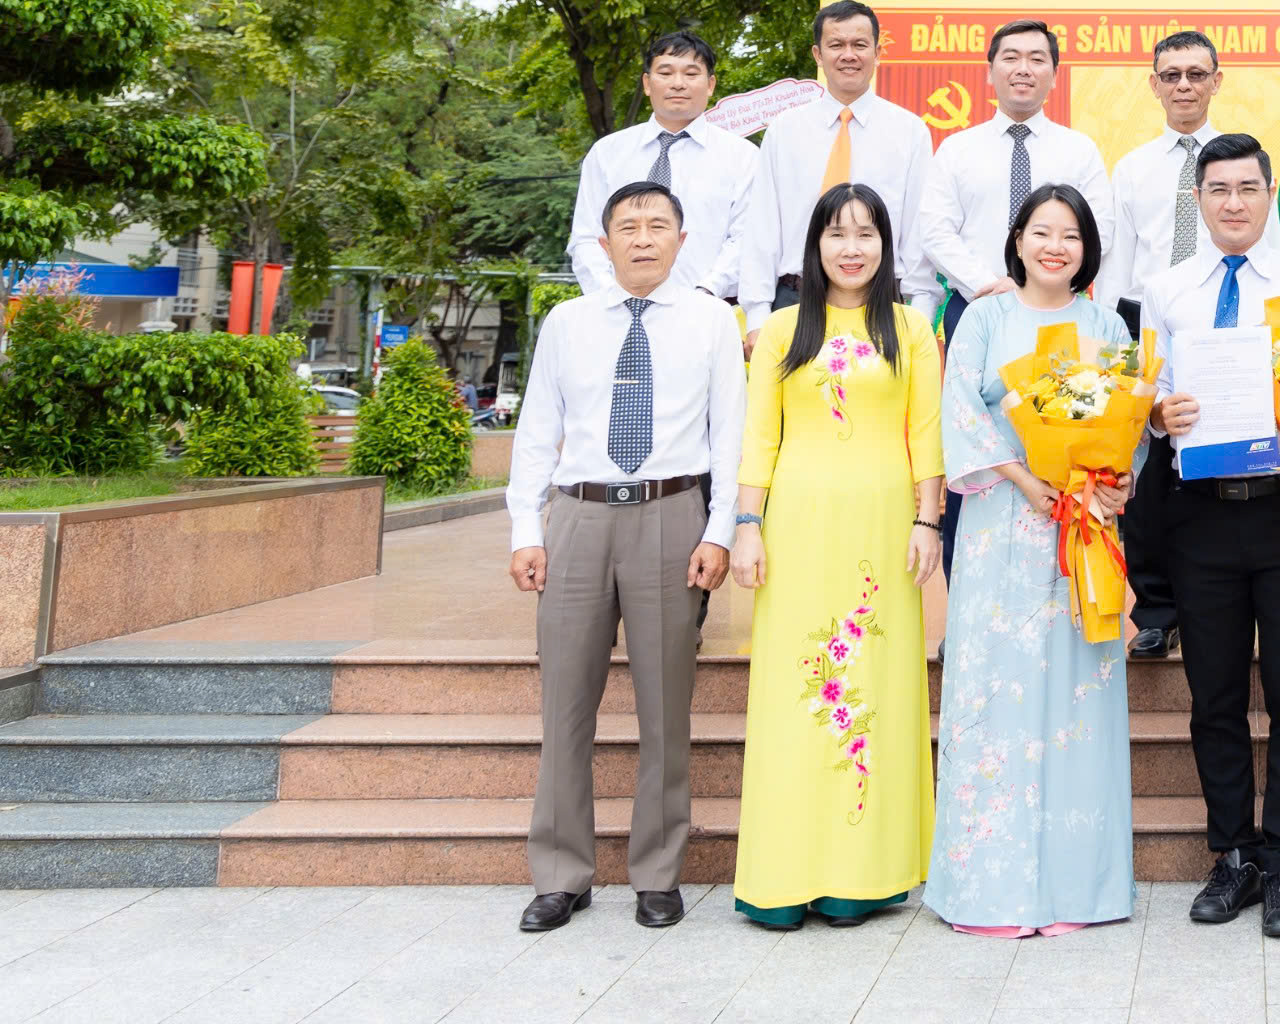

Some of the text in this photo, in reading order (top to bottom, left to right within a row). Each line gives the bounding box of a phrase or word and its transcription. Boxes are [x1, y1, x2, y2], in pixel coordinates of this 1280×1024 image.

[911, 15, 985, 53] ĐẢNG
[1076, 16, 1131, 53] SẢN
[1140, 19, 1197, 53] VI
[1204, 25, 1267, 53] NAM
